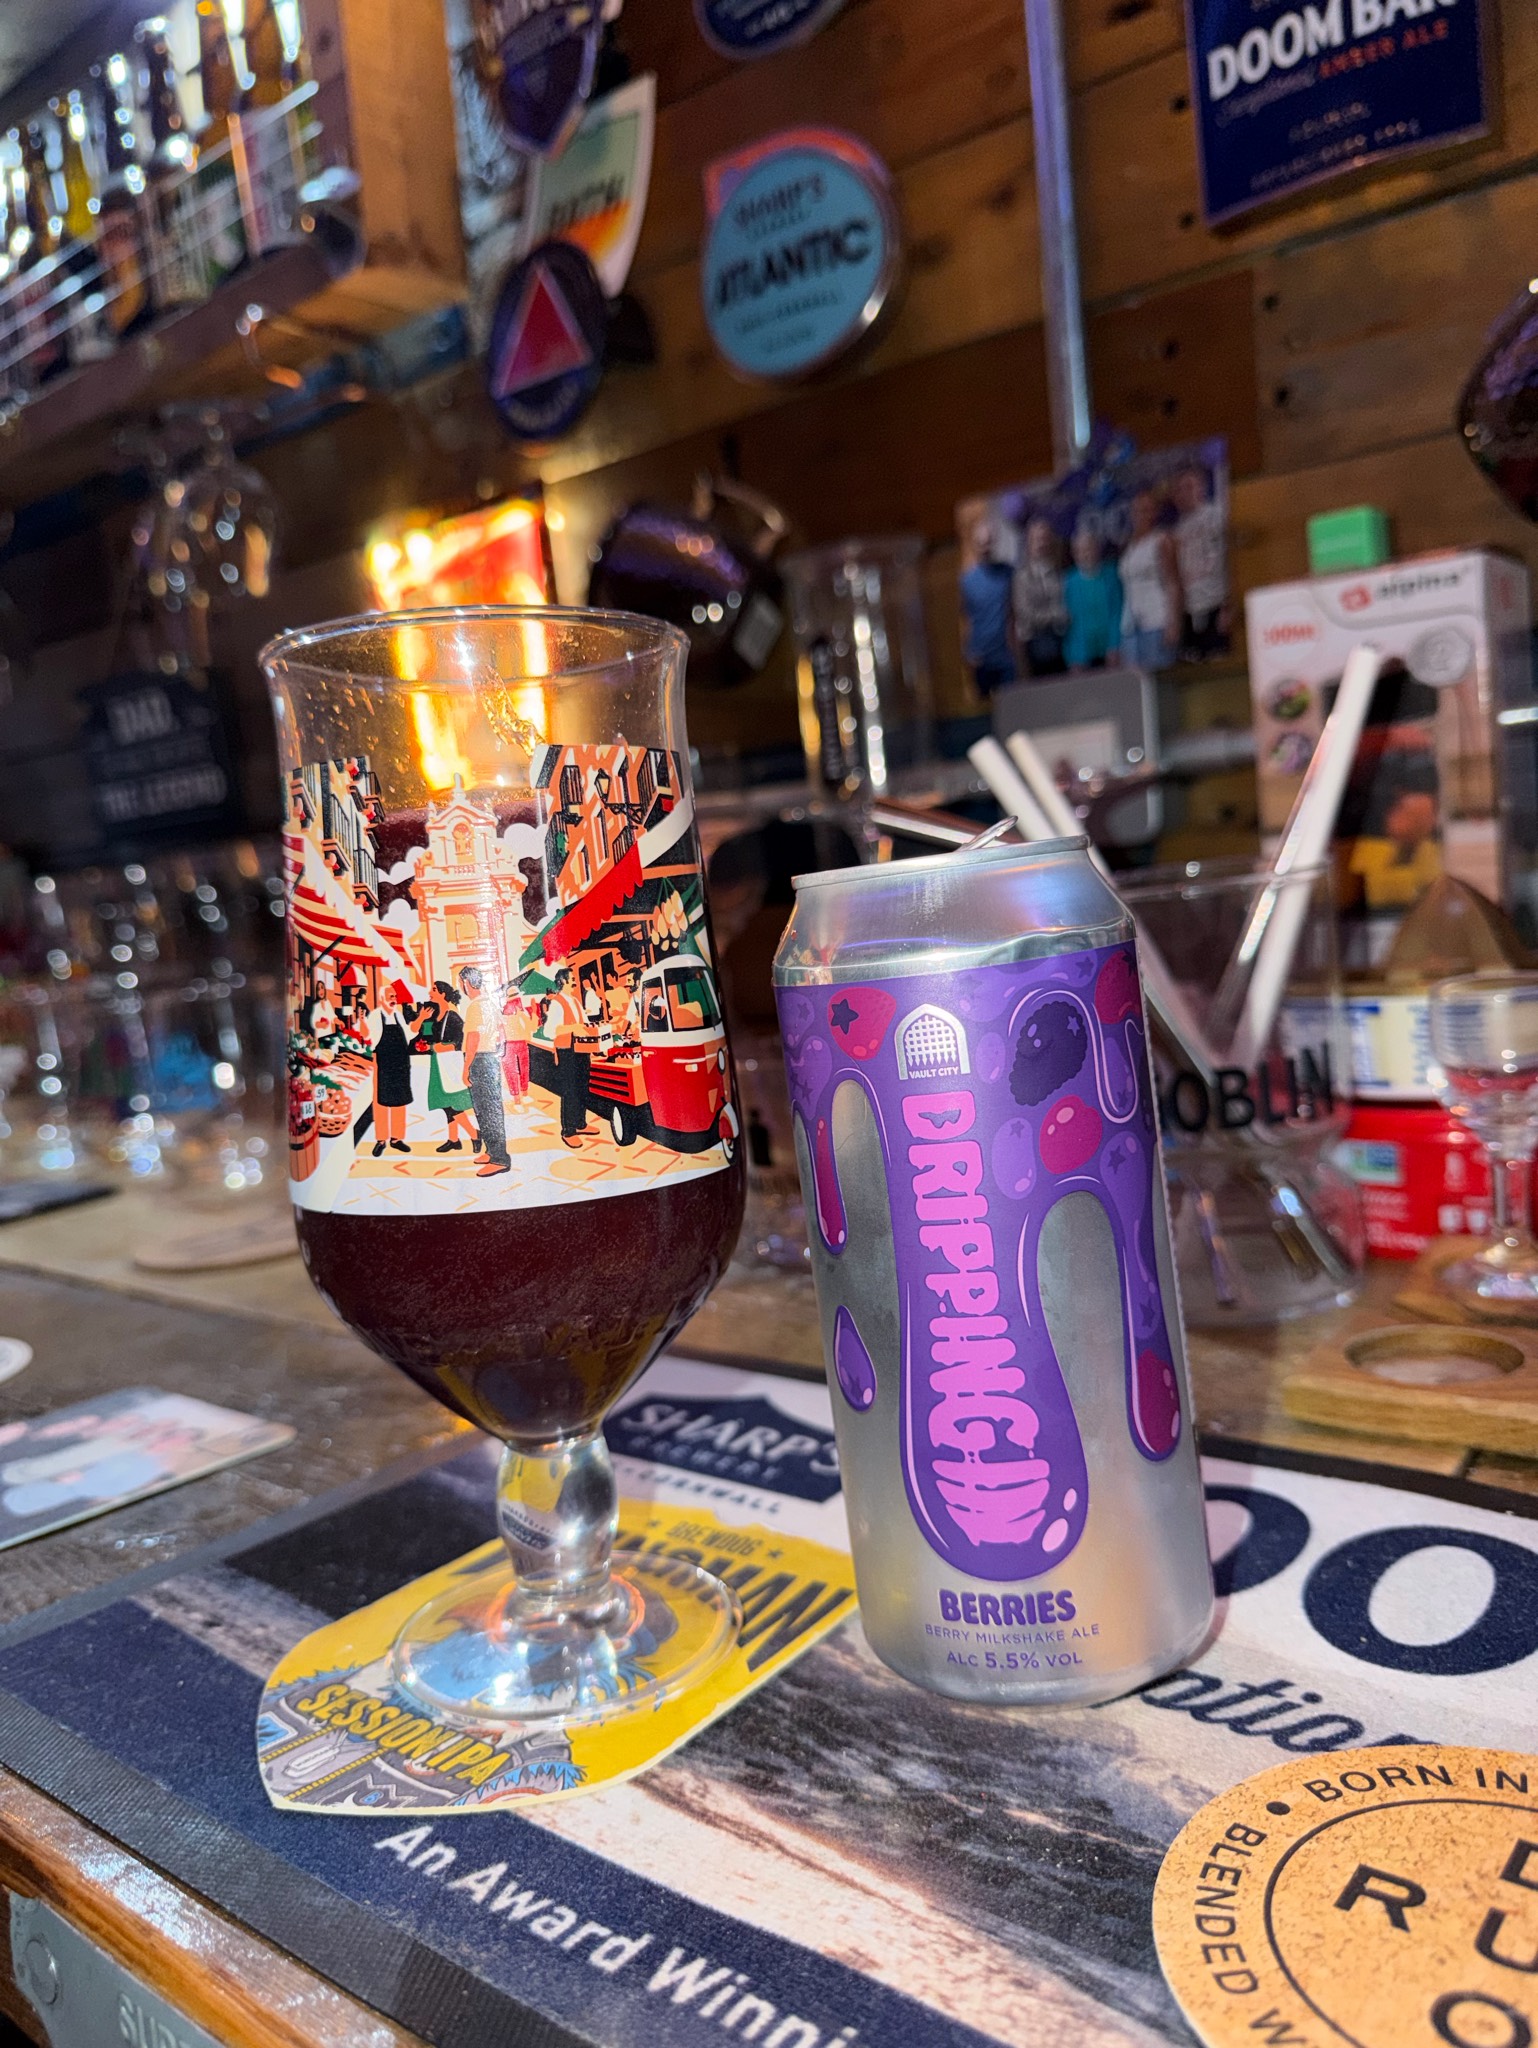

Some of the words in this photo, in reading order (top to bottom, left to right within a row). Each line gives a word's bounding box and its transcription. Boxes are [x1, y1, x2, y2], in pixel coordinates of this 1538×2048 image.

[1207, 0, 1346, 101] DOOM
[909, 1069, 937, 1079] VAULT
[938, 1066, 959, 1077] CITY
[1156, 1042, 1334, 1133] OBLIN
[902, 1090, 1040, 1455] DRIPPING
[667, 1521, 764, 1557] BREWDOG
[925, 1624, 970, 1641] BERRY
[976, 1629, 1065, 1645] MILKSHAKE
[1071, 1623, 1100, 1639] ALE
[939, 1588, 1076, 1626] BERRIES
[947, 1651, 978, 1667] ALC
[985, 1651, 1040, 1669] 5.5%
[1045, 1652, 1082, 1668] VOL
[297, 1683, 456, 1760] SESSION
[425, 1729, 511, 1787] IPA
[1303, 1765, 1453, 1802] BORN
[1475, 1767, 1529, 1793] IN
[374, 1825, 459, 1878] An
[447, 1861, 654, 1974] Award
[1195, 1822, 1267, 1995] BLENDED
